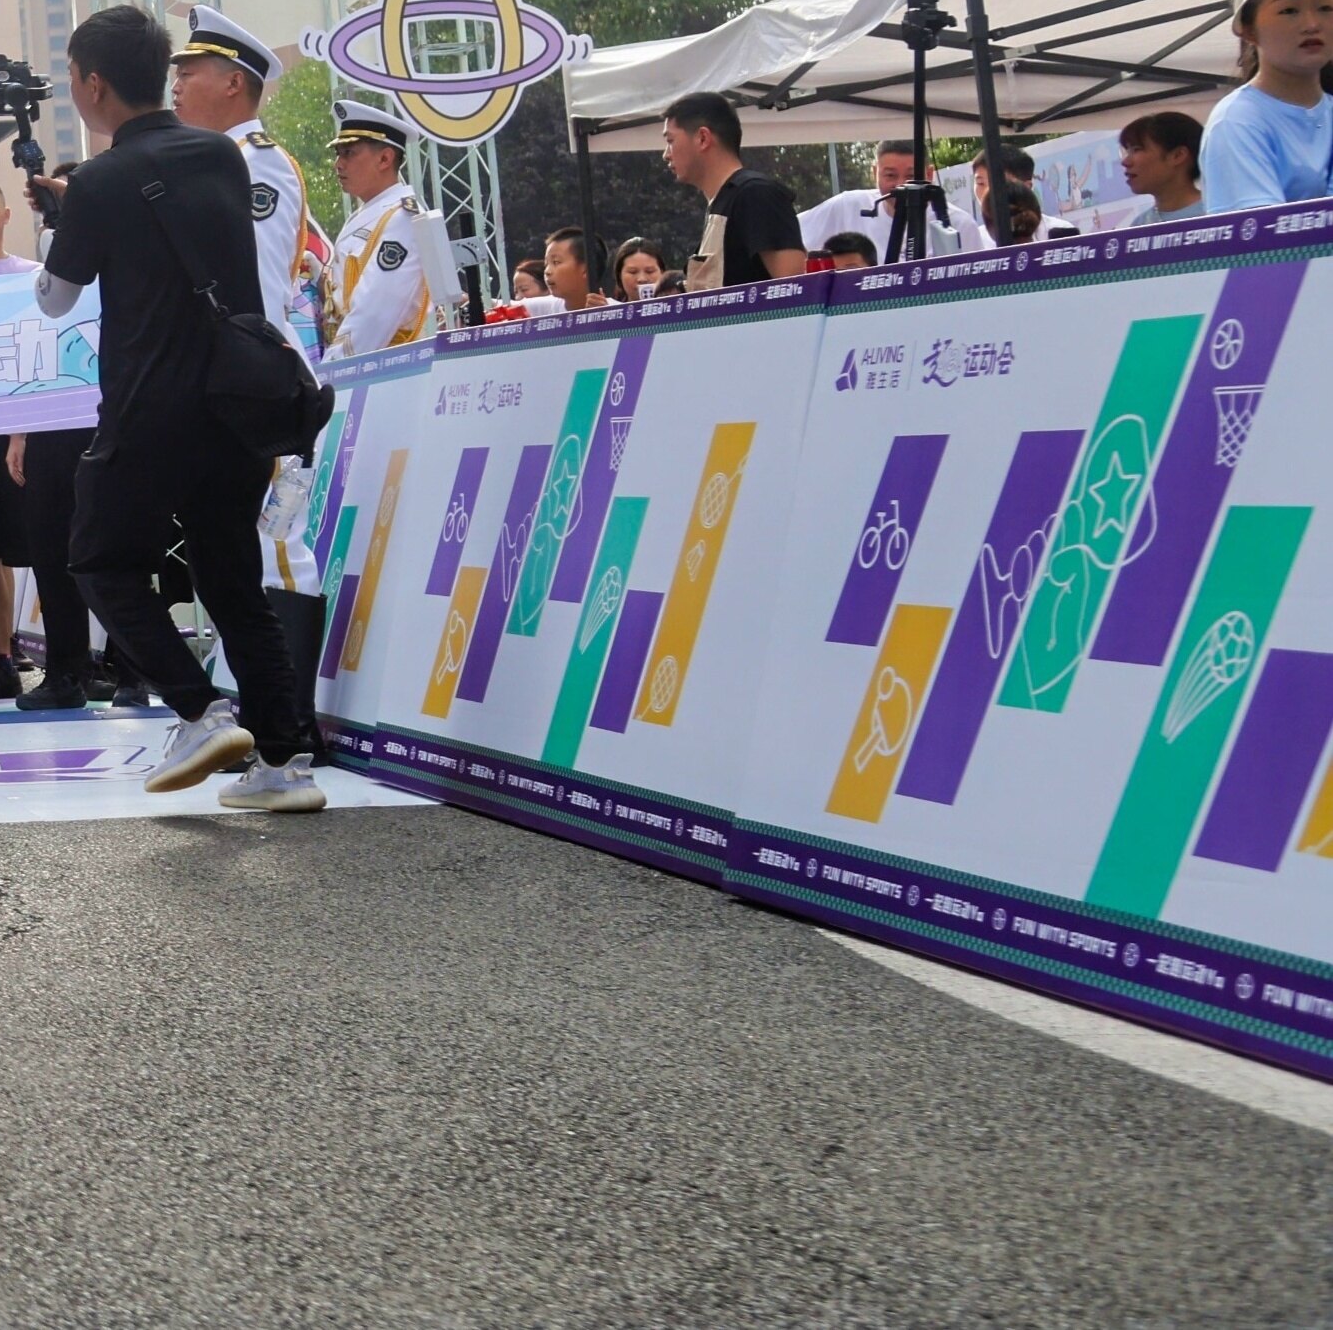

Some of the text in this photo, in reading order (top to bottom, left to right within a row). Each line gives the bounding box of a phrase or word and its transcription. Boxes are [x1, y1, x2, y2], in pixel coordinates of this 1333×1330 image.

[927, 266, 945, 281] FUN
[947, 262, 972, 278] WITH
[974, 257, 1009, 274] SPORTS
[1126, 237, 1149, 253] FUN
[1152, 232, 1183, 249] WITH
[1185, 225, 1233, 245] SPORTS
[861, 345, 906, 366] A-LIVING
[963, 341, 1015, 378] 运动会
[822, 864, 840, 884] FUN
[842, 869, 865, 890] WITH
[866, 876, 902, 900] SPORTS
[1013, 916, 1035, 936] FUN
[1038, 923, 1069, 946] WITH
[1069, 931, 1117, 959] SPORTS
[1261, 983, 1295, 1007] FUN
